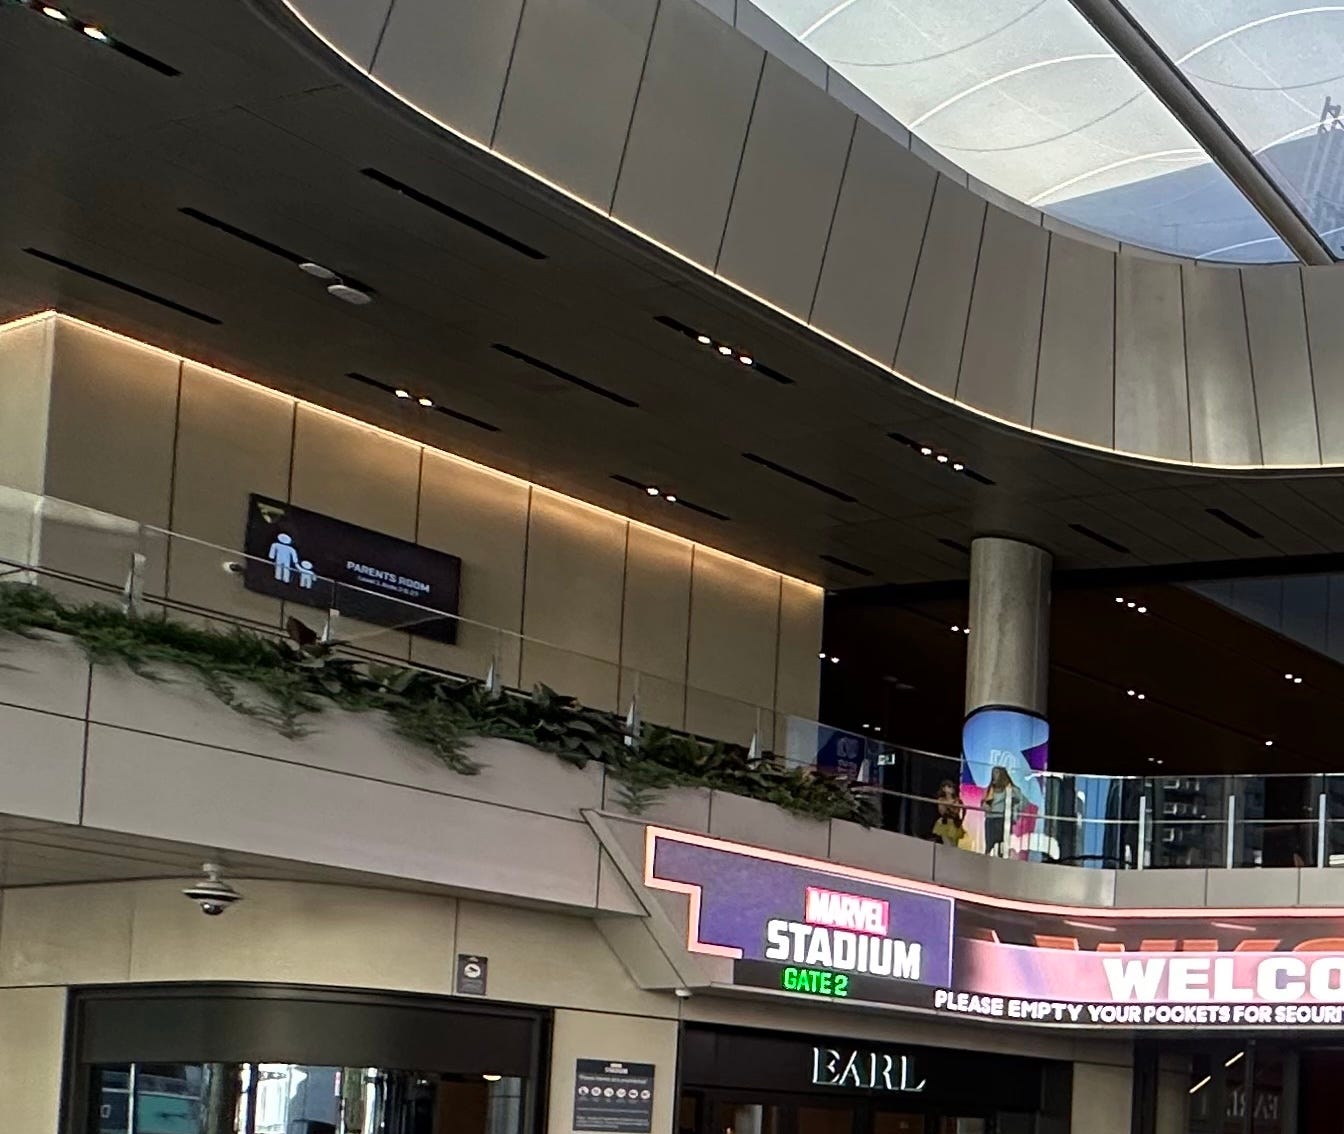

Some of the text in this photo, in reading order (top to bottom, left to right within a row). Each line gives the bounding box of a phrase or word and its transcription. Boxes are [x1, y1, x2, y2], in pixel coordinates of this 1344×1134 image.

[346, 561, 396, 583] PARENTS
[809, 889, 887, 934] MARVEL
[765, 919, 922, 980] STADIUM
[784, 967, 849, 996] GATE 2
[934, 989, 1003, 1015] PLEASE
[1008, 1000, 1083, 1022] EMPTY
[1087, 1005, 1141, 1023] YOUR
[1144, 1005, 1231, 1023] POCKETS
[1233, 1005, 1274, 1023] FOR
[813, 1047, 926, 1092] EARL
